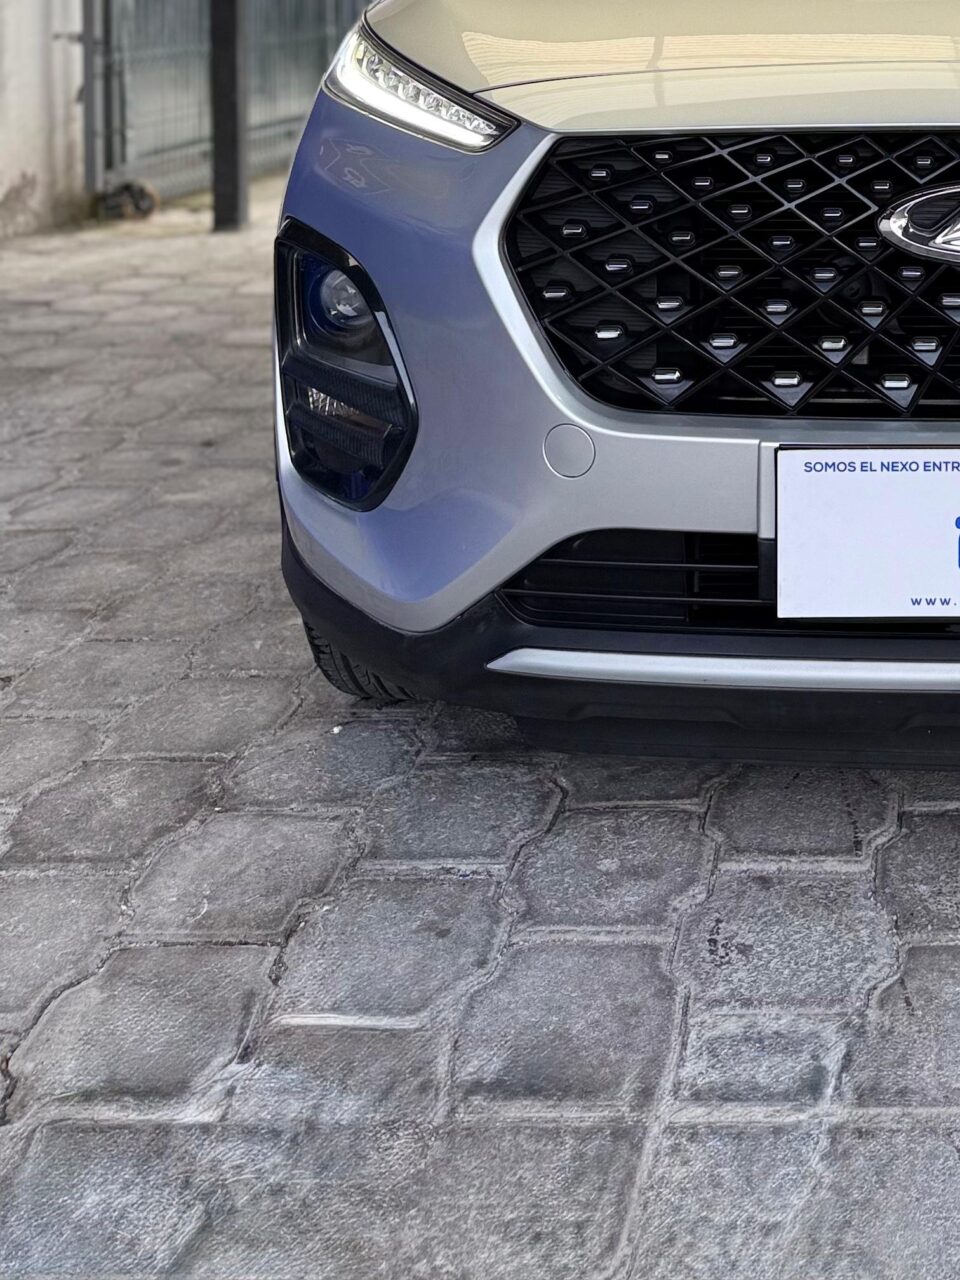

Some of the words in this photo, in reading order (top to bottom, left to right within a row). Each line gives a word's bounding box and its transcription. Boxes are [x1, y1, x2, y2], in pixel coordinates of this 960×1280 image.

[803, 461, 857, 473] SOMOS
[860, 461, 878, 473] EL
[880, 461, 920, 473] NEXO
